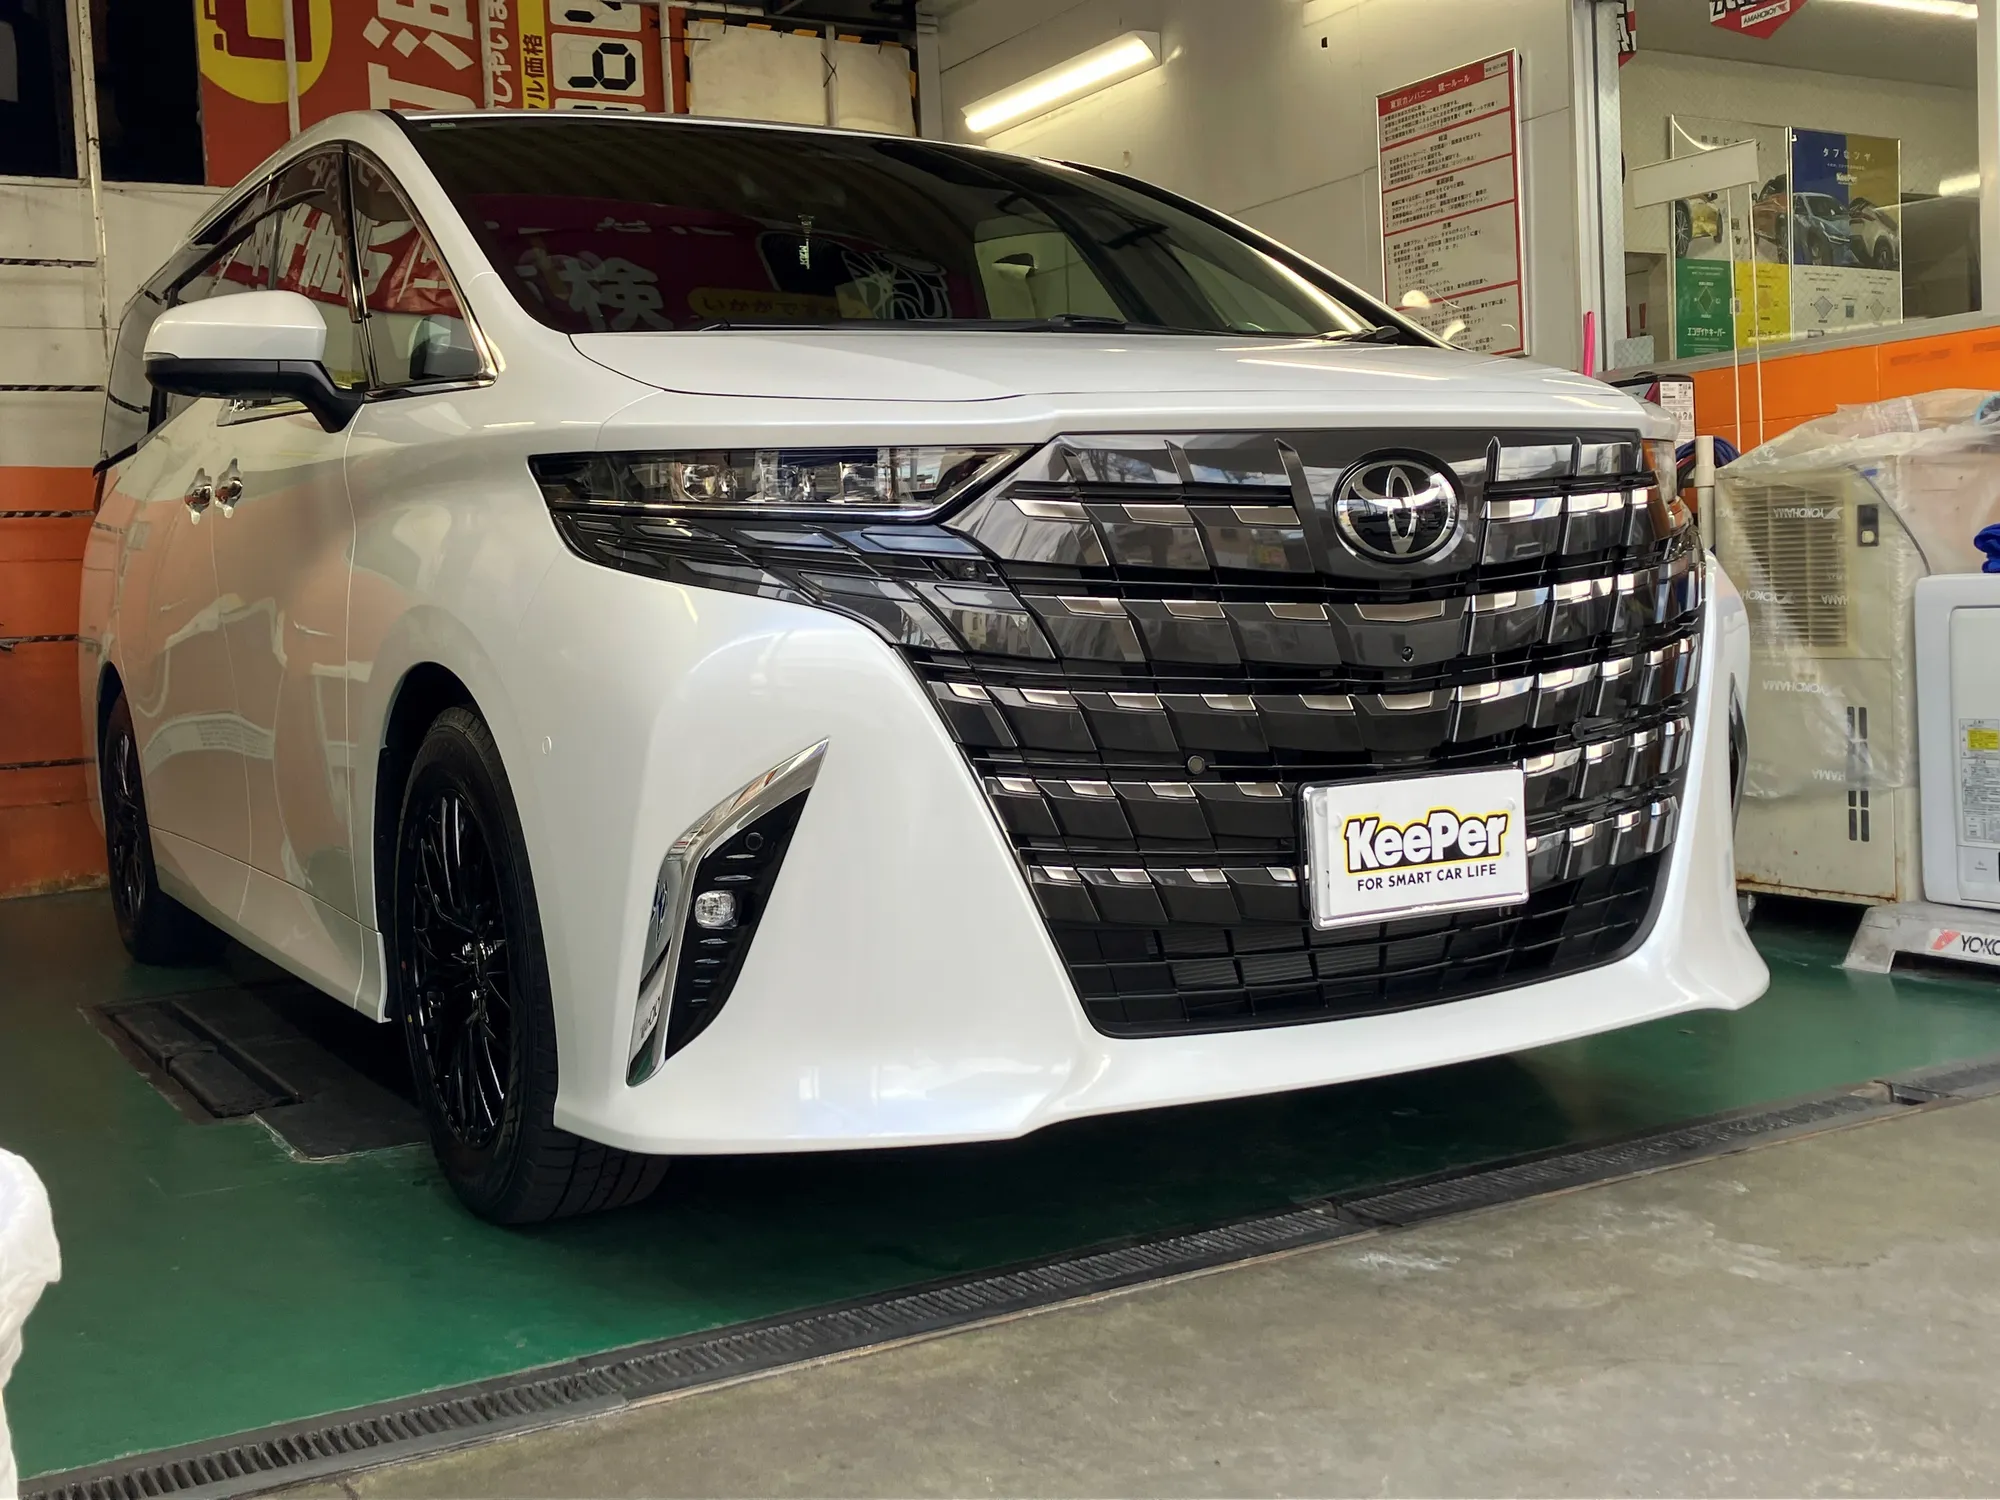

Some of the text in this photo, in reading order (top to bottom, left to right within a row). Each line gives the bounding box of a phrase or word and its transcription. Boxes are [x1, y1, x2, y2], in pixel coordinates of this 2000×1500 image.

[1773, 508, 1824, 518] YOKOHAMA
[1762, 679, 1829, 696] YOKOHAMA
[1345, 810, 1508, 872] KeePer
[1357, 863, 1497, 891] FOR SMART CAR LIFE
